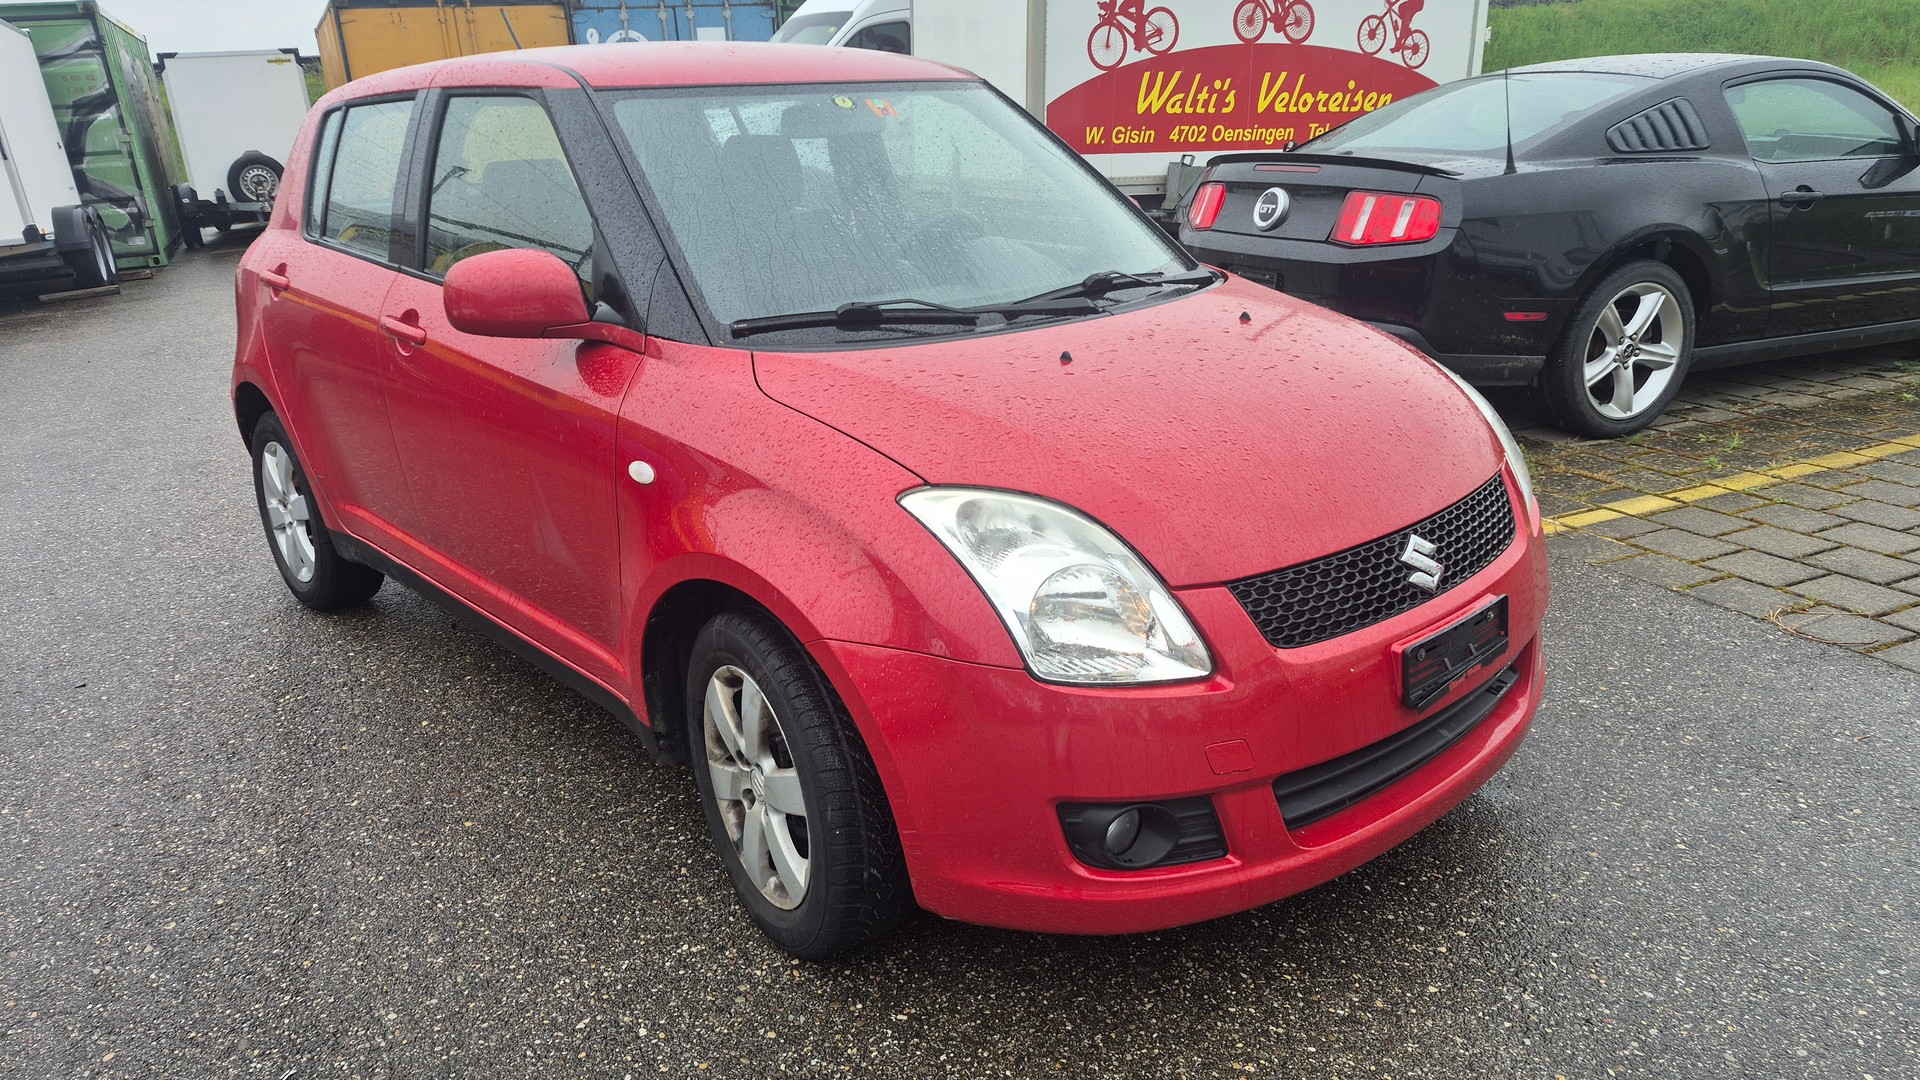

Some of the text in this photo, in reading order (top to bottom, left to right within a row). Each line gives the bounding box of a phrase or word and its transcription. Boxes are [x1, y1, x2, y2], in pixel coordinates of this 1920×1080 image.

[1137, 70, 1393, 115] Walti's Veloreisen
[1085, 126, 1105, 144] W.
[1111, 126, 1155, 144] Gisin
[1169, 125, 1208, 143] 4702
[1211, 124, 1295, 145] Oensingen
[1259, 203, 1277, 214] GT
